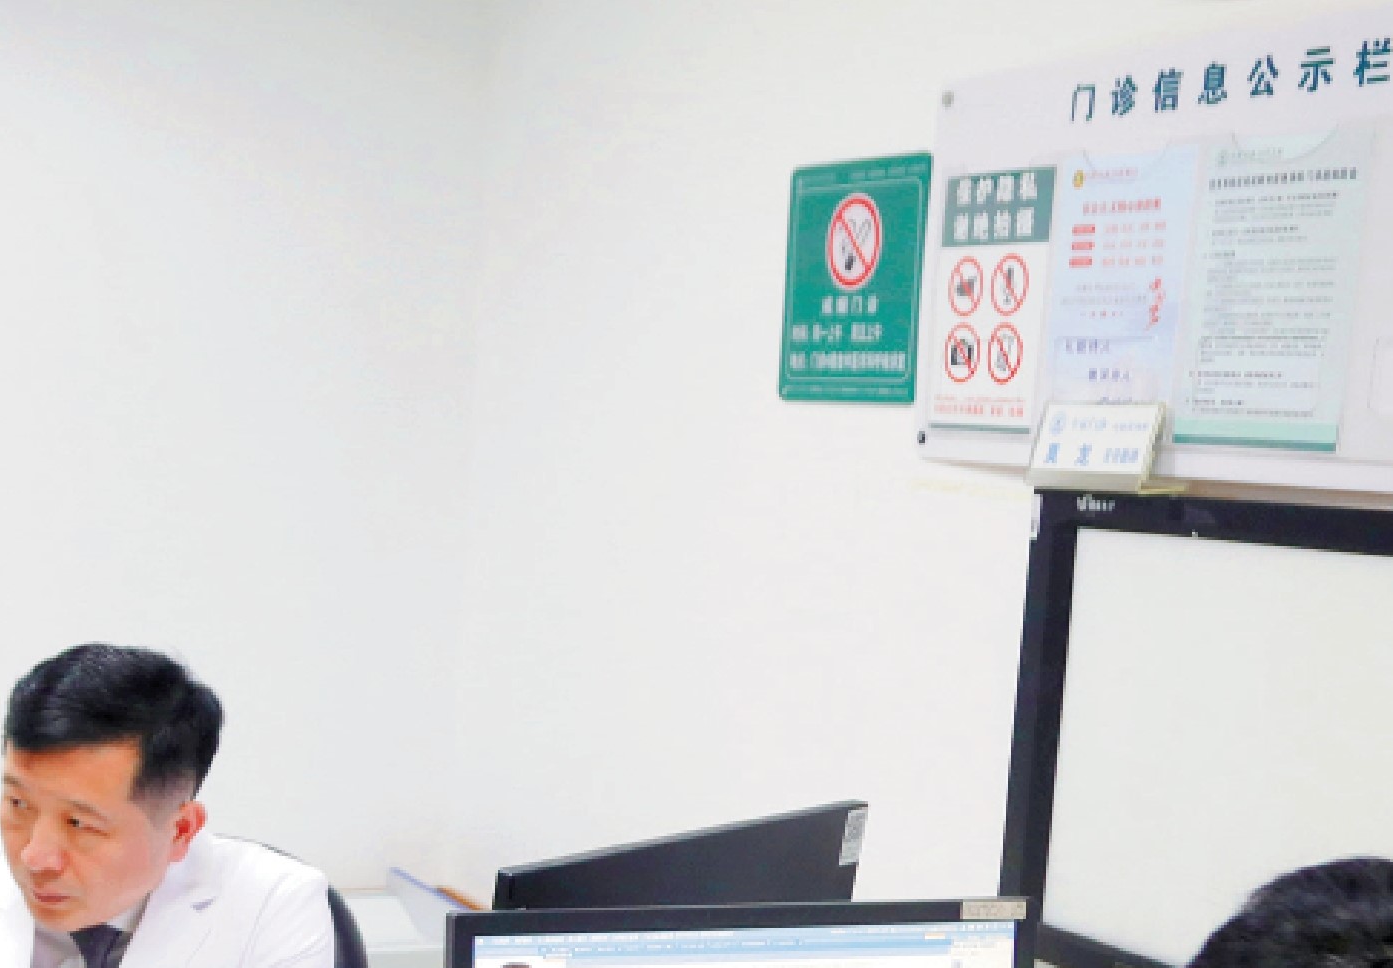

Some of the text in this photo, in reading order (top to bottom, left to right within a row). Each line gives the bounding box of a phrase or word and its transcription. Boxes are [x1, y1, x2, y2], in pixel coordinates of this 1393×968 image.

[1070, 38, 1392, 122] 门诊信息公示栏
